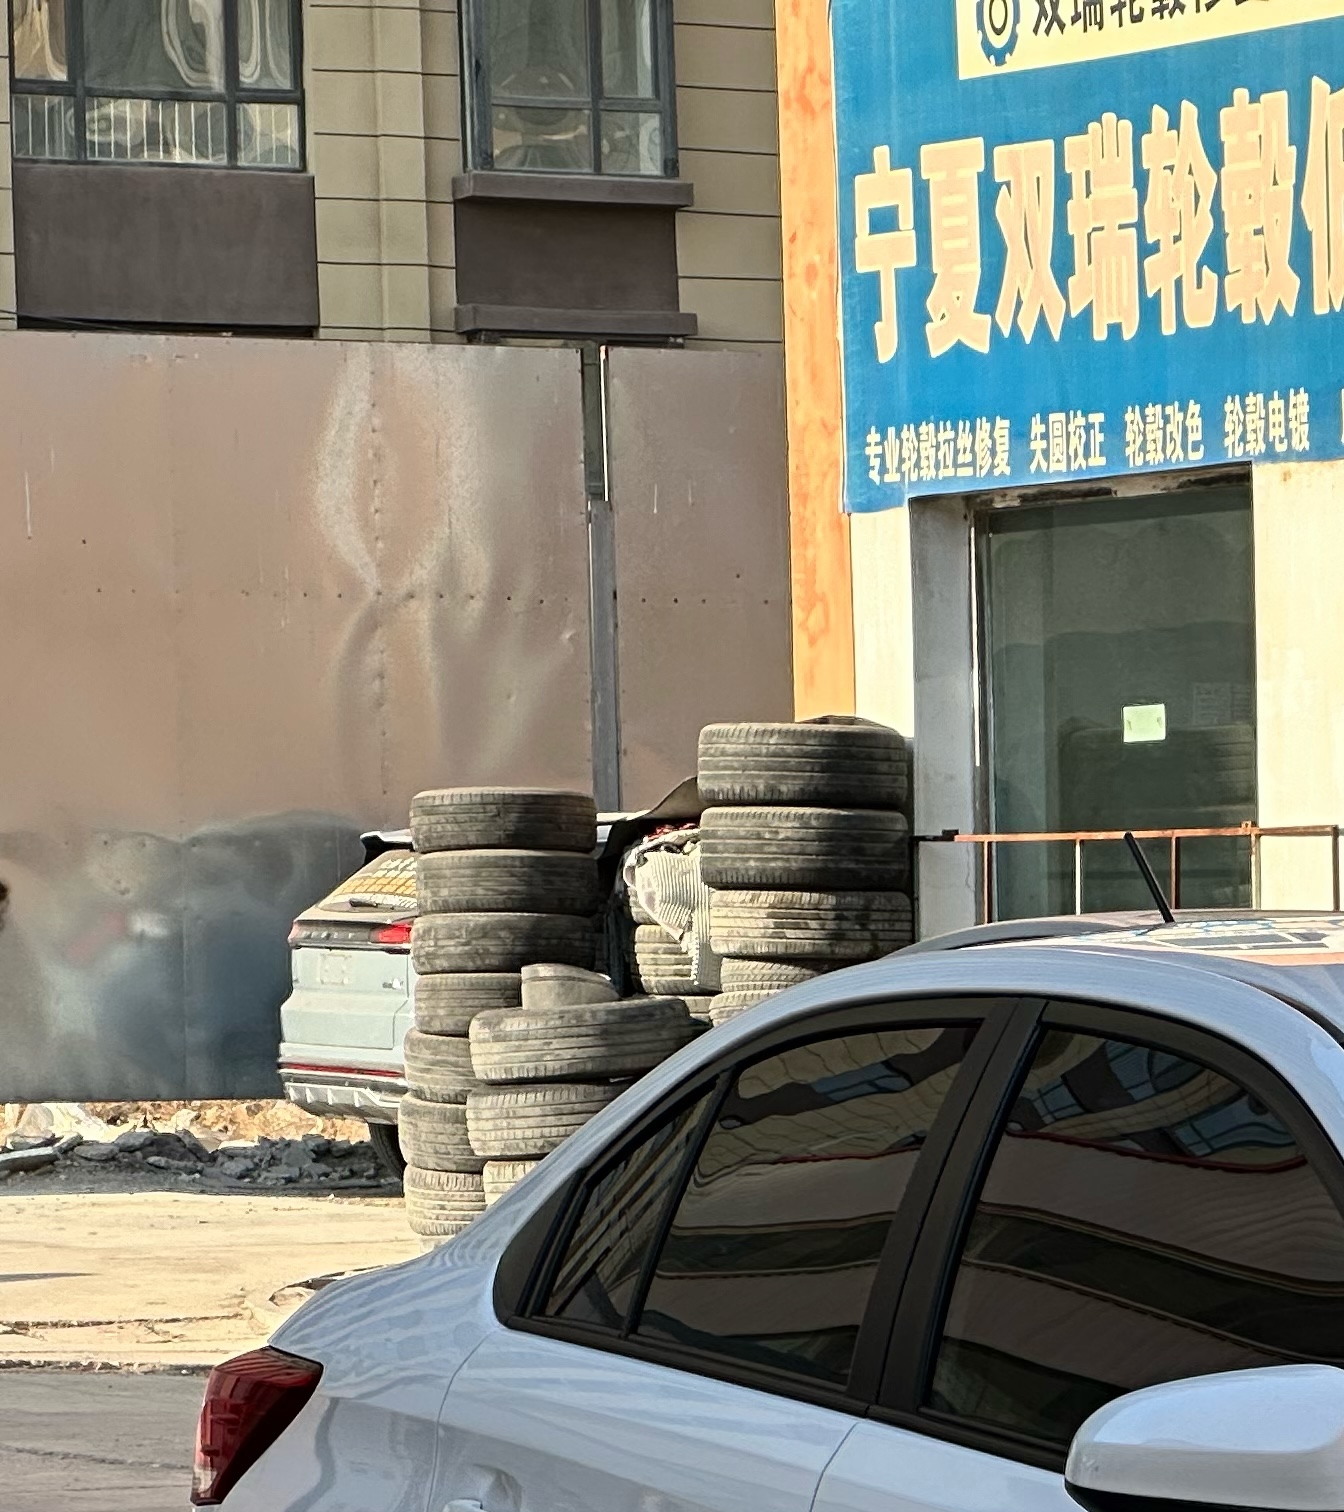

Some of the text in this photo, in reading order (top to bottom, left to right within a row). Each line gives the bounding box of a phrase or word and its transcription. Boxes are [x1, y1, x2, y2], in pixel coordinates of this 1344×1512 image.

[864, 414, 1011, 485] 专业轮毂拉丝修复
[1029, 410, 1107, 474] 失圆校正
[1125, 399, 1205, 468] 轮毂改色
[1223, 387, 1310, 458] 轮毂电镀
